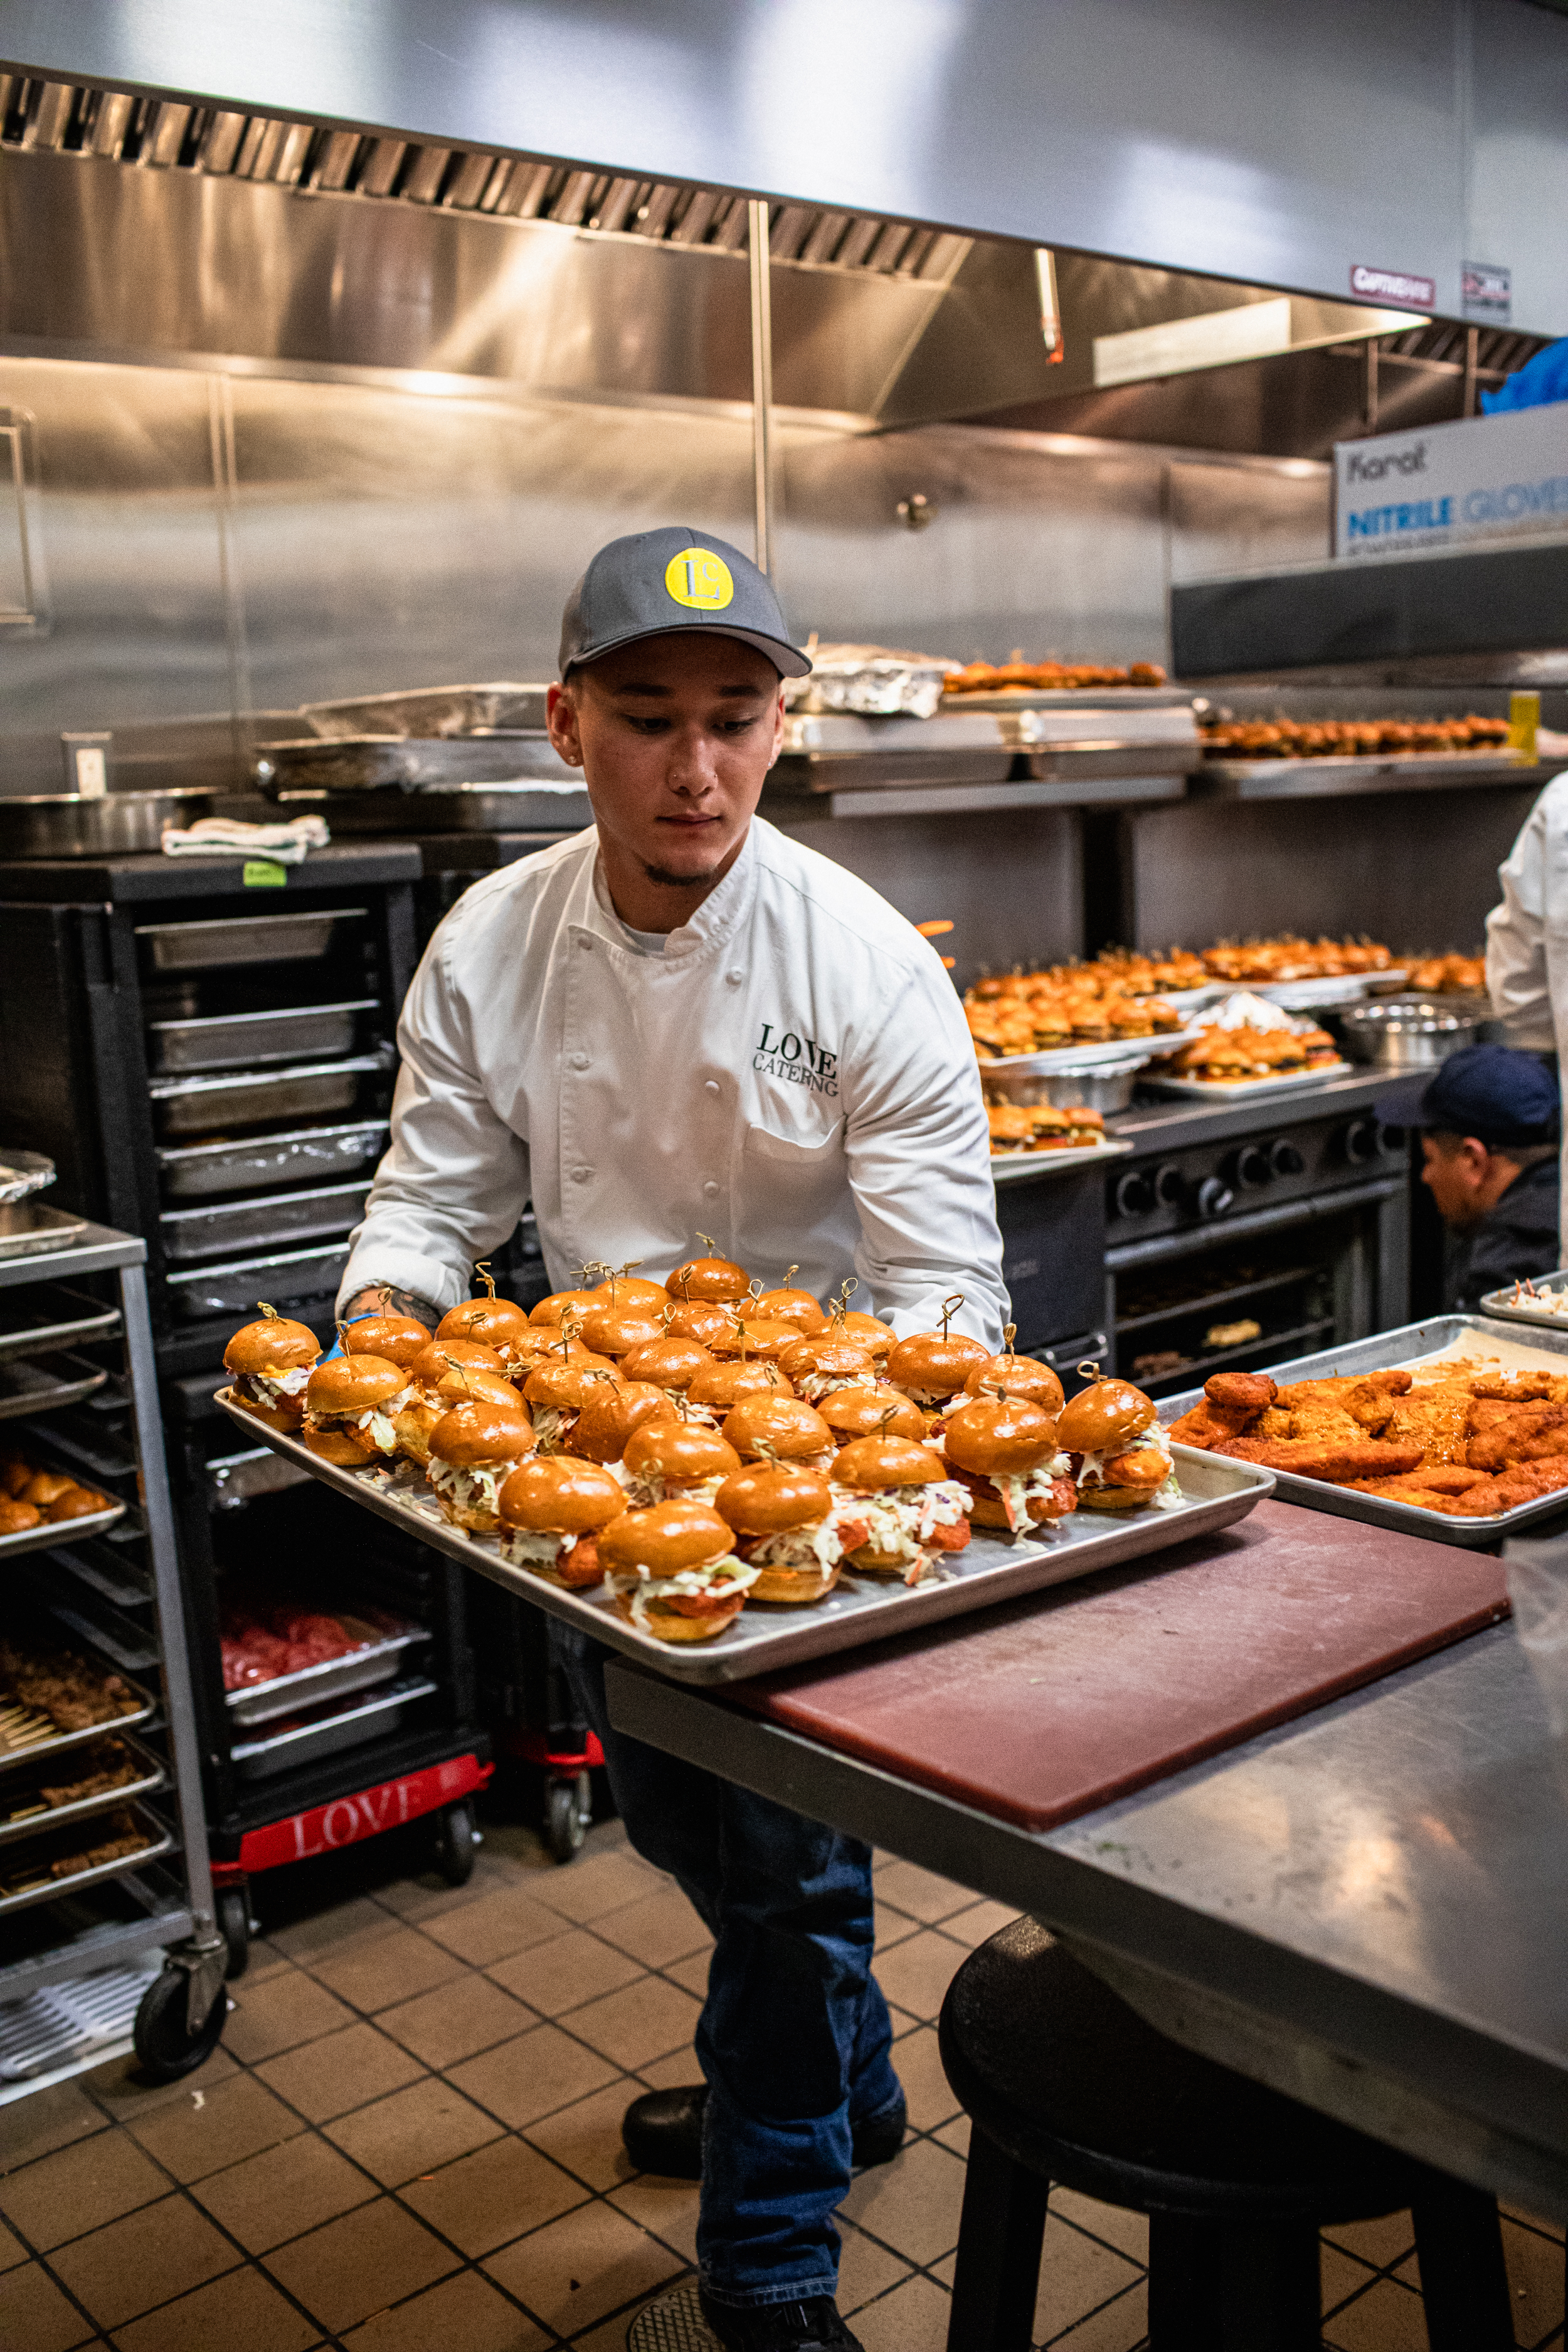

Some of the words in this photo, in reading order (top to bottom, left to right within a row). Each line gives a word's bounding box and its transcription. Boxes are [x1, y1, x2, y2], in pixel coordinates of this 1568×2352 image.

[1348, 496, 1452, 538] NITRILE
[1463, 476, 1568, 523] GLOVE
[753, 1053, 839, 1098] CATERNG
[756, 1023, 837, 1079] LOVE
